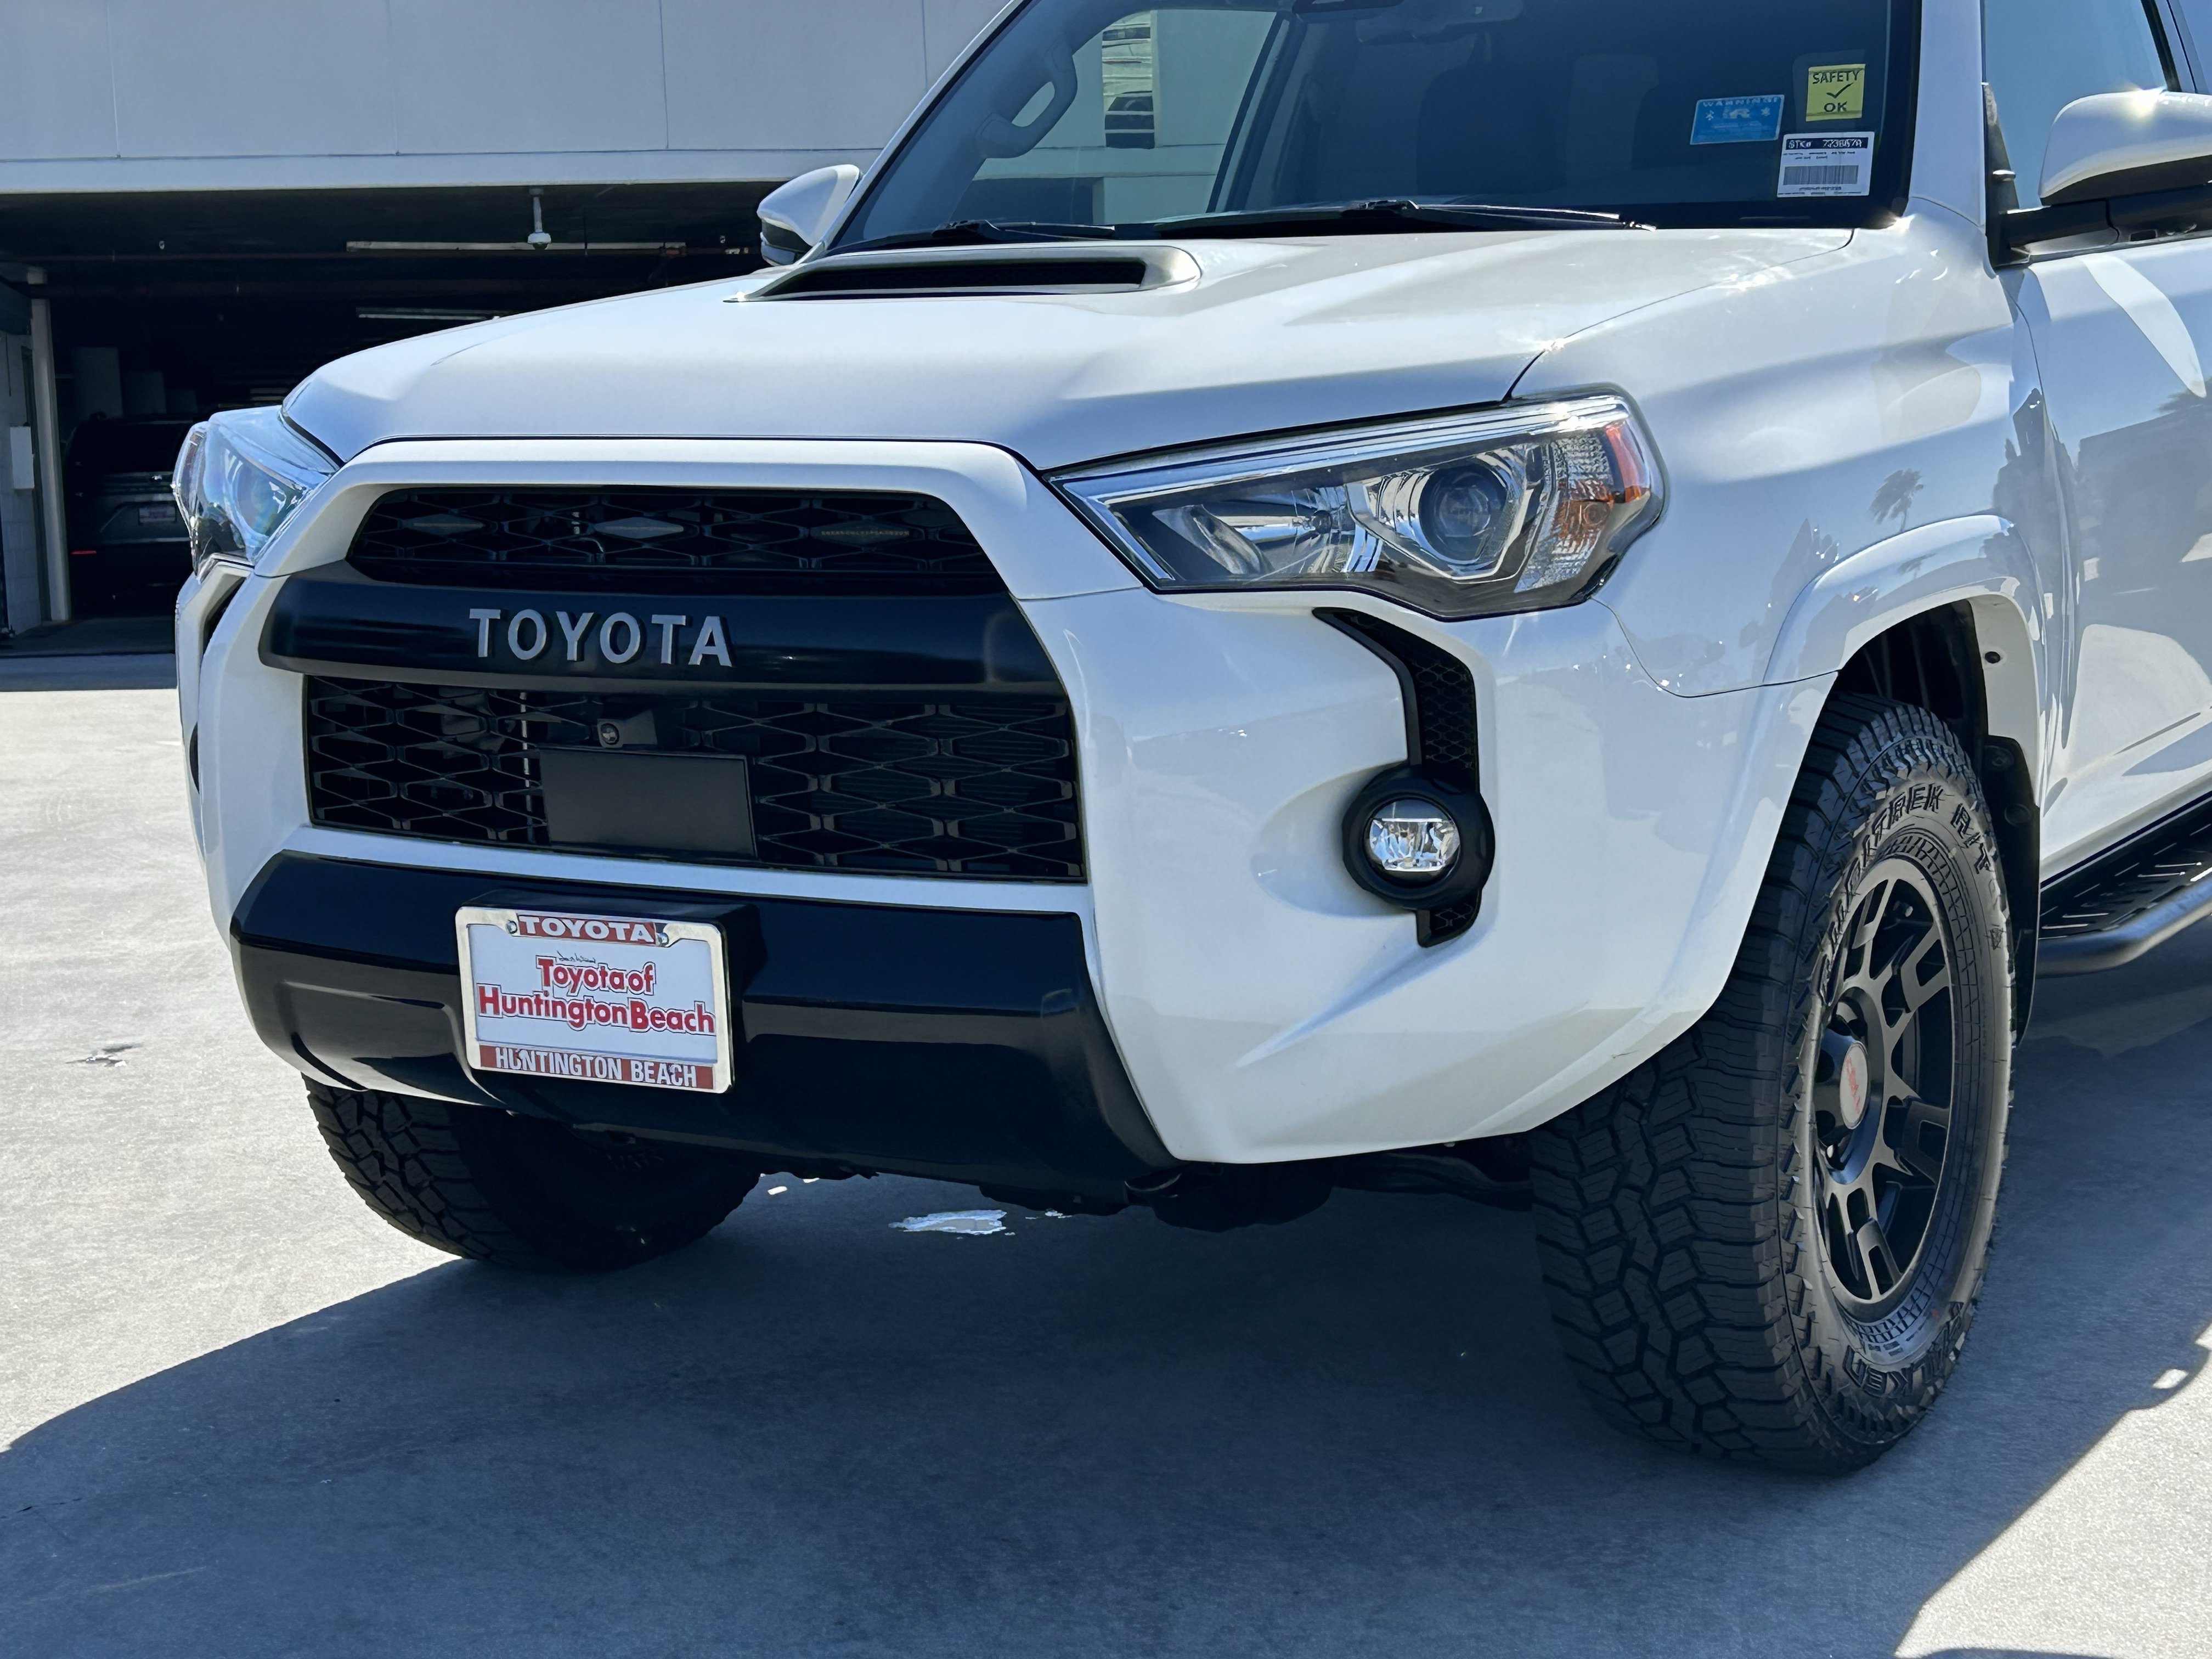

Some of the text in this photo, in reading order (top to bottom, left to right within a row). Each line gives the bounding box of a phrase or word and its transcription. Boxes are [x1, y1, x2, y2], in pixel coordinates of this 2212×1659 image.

[1812, 70, 1860, 84] SAFETY
[1824, 101, 1848, 113] OK
[469, 608, 733, 667] TOYOTA
[518, 915, 654, 943] TOYOTA
[537, 956, 626, 995] Toyota
[627, 963, 654, 994] of
[478, 984, 714, 1034] Huntington Beach
[495, 1047, 697, 1087] HUNTINGTON BEACH
